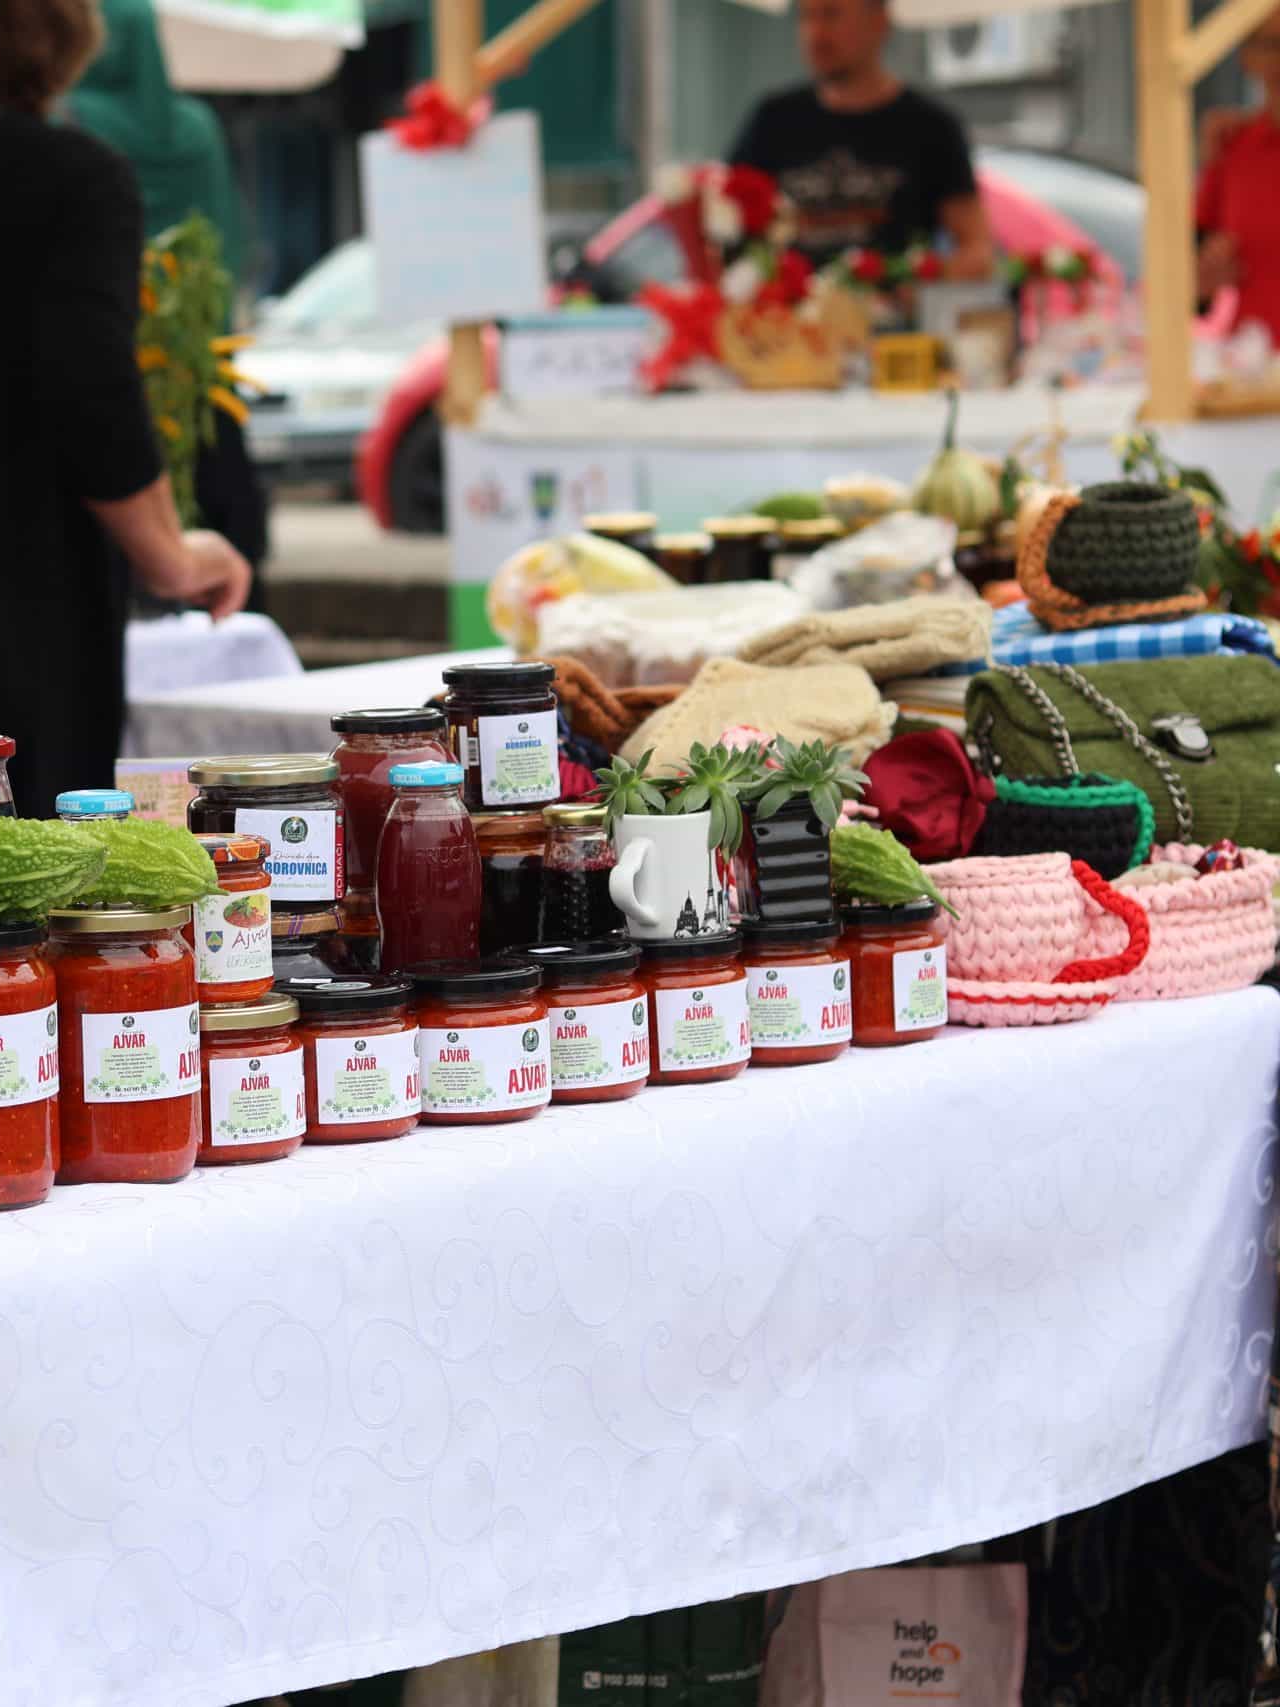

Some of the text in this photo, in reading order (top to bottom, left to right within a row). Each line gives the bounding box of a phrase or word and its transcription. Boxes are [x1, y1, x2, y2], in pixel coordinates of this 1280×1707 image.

[265, 862, 328, 875] BOROVNICA
[757, 986, 789, 1000] AJVAR
[684, 1006, 714, 1021] AJVAR
[113, 1033, 146, 1049] AJVAR
[556, 1025, 588, 1041] AJVAR
[439, 1048, 471, 1063] AJVAR
[346, 1056, 377, 1072] AJVAR
[240, 1075, 270, 1092] AJVAR
[507, 1063, 548, 1094] AJVAR
[893, 1619, 938, 1645] help
[889, 1661, 945, 1688] hope
